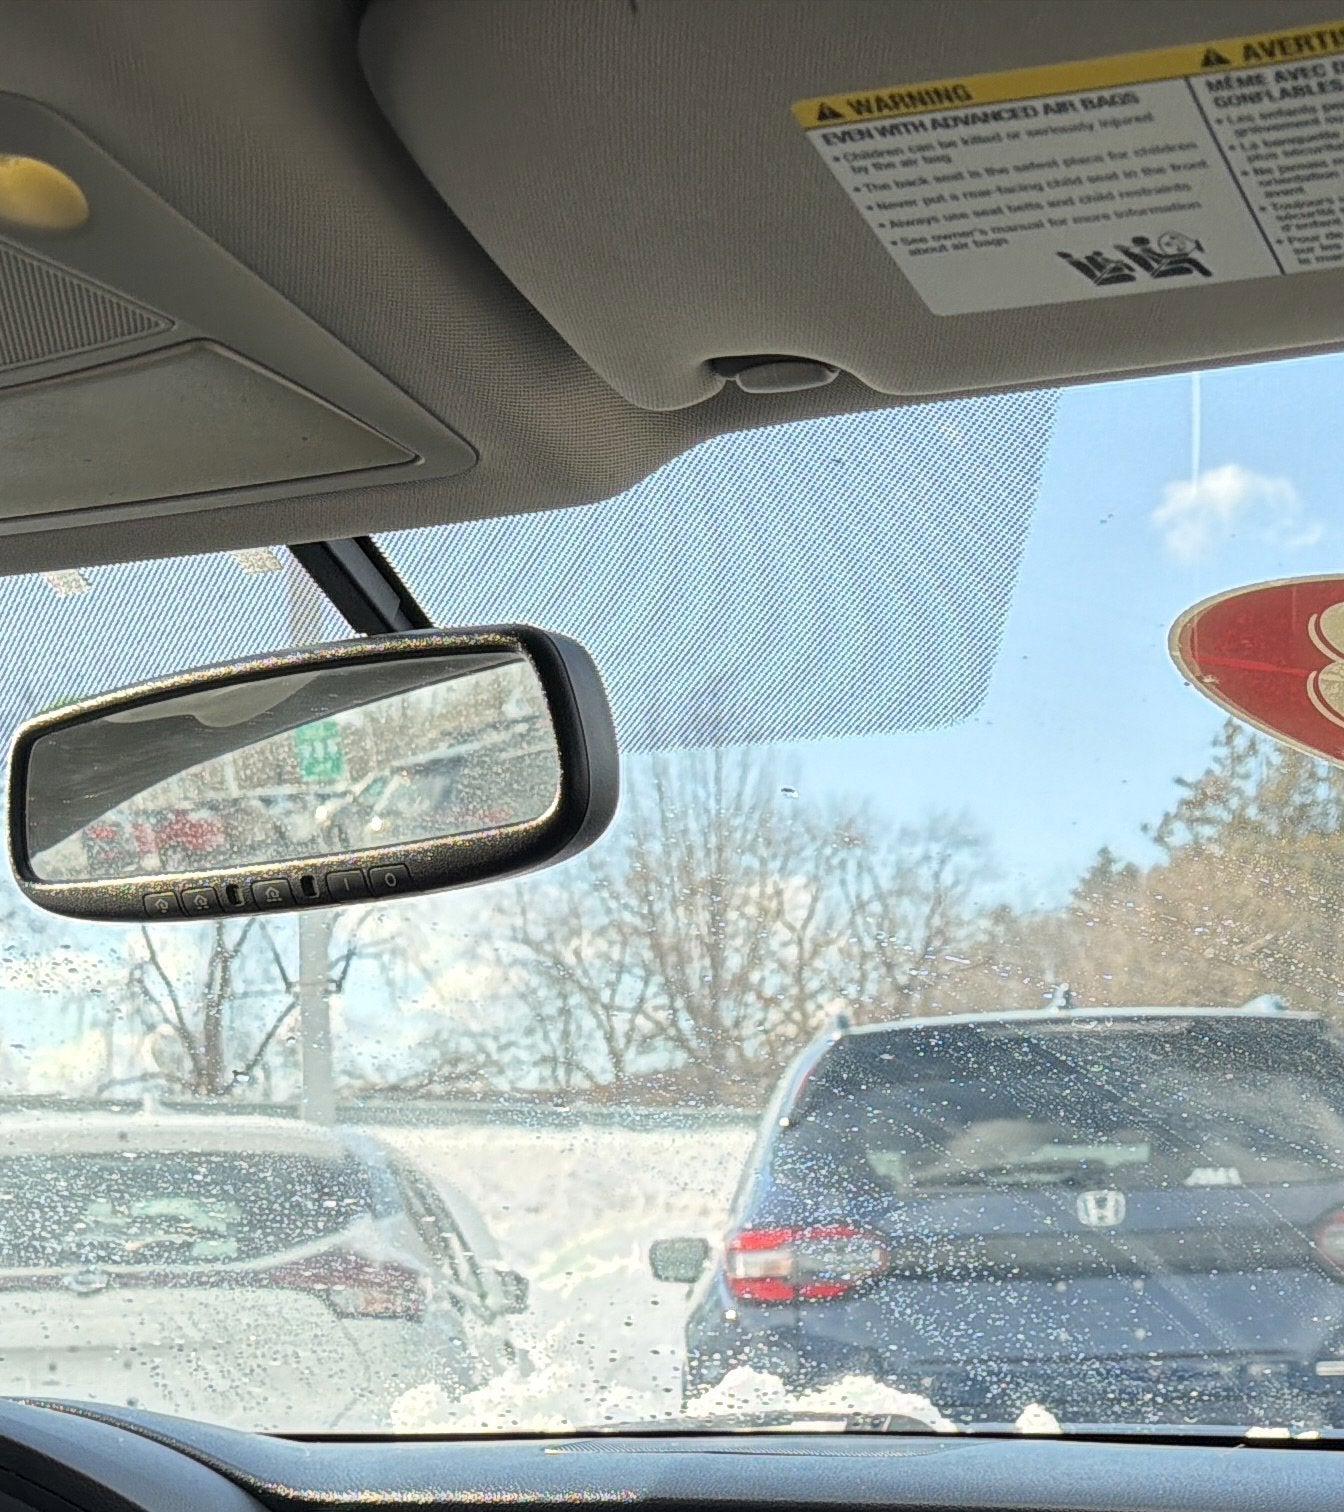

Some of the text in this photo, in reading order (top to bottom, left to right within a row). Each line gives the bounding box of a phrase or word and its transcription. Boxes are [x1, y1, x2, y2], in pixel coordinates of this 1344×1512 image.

[820, 90, 1139, 146] EVEN WITH ADVANCED AIR BAGS
[847, 84, 974, 116] WARNING
